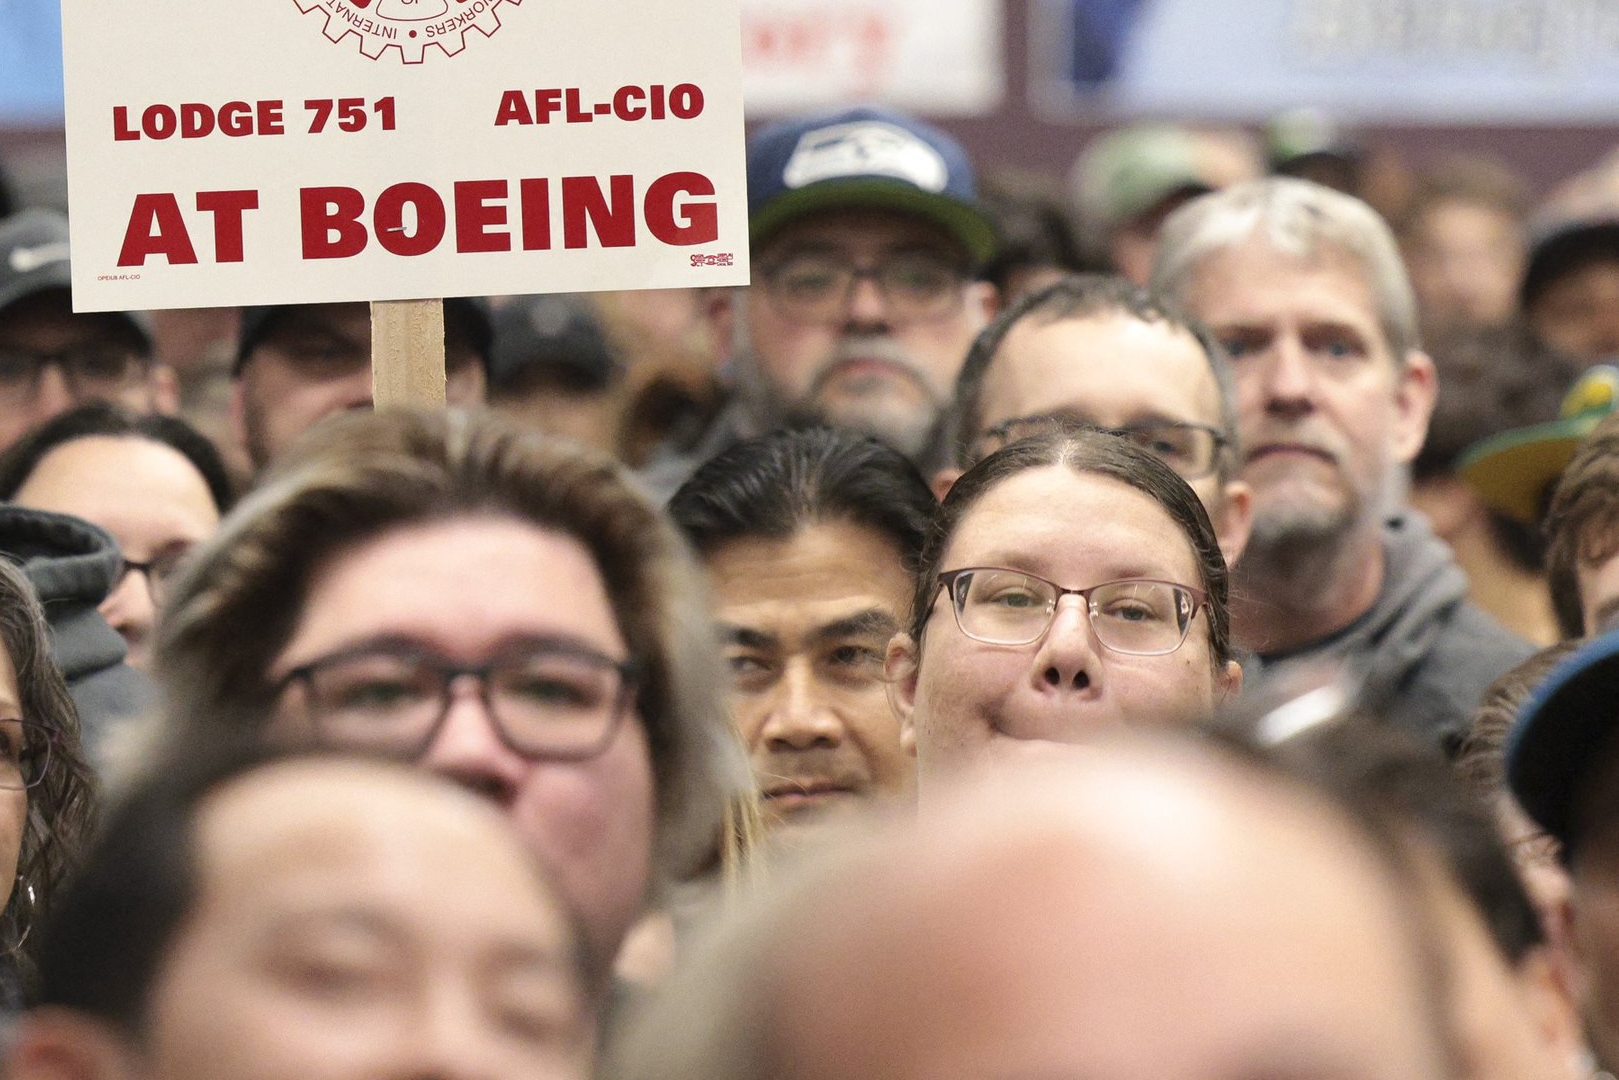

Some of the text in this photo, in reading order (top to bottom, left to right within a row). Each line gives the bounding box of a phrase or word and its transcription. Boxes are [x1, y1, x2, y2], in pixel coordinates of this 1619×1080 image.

[112, 83, 705, 142] LODGE 751 AFL-CIO
[117, 171, 719, 267] AT BOEING
